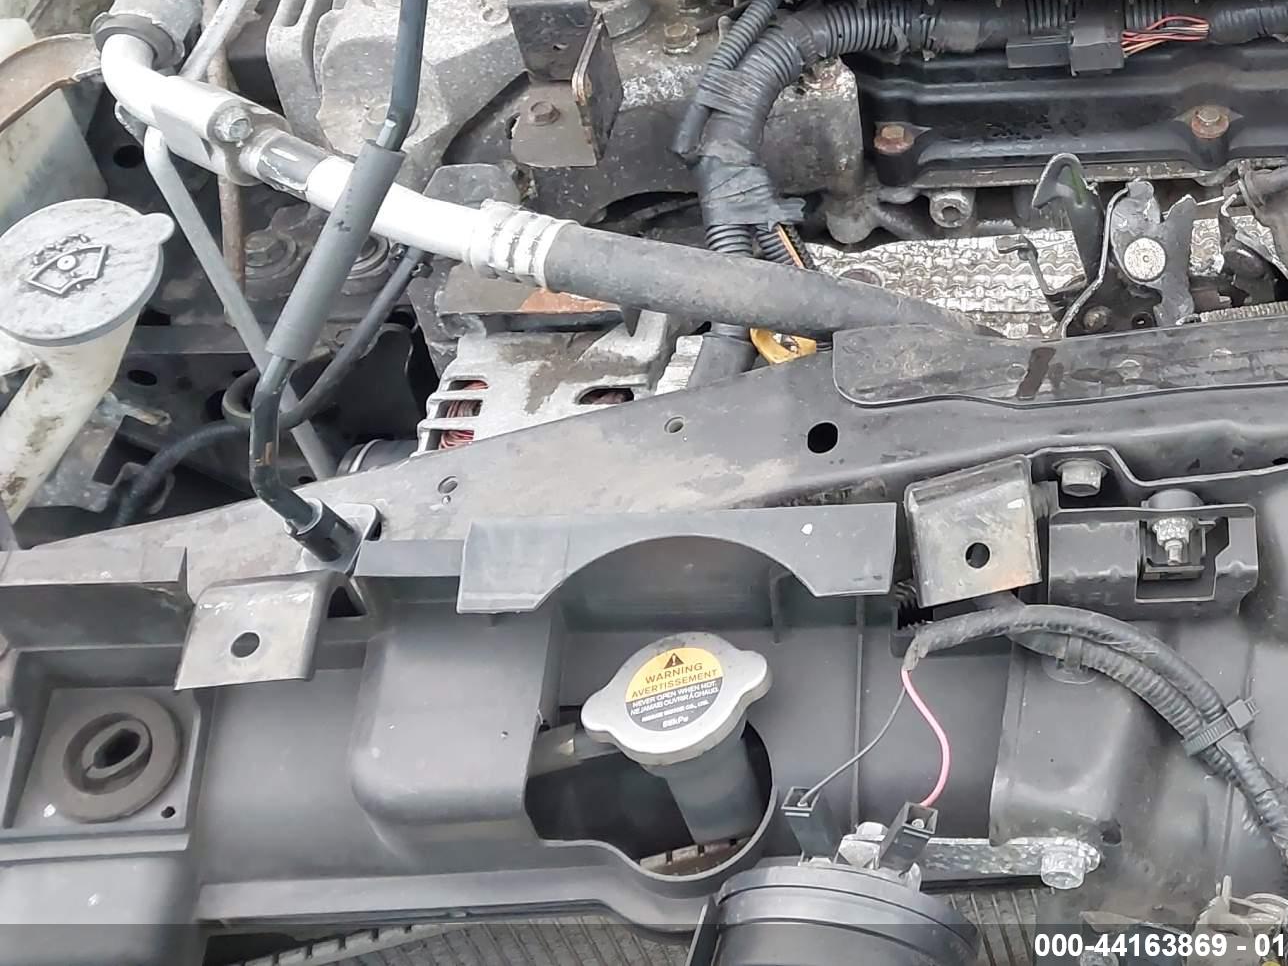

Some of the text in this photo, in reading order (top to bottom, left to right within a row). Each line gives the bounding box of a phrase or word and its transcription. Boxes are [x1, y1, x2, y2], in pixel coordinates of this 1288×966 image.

[631, 668, 718, 699] AVERTISSEMENT
[645, 662, 703, 684] WARNING
[632, 695, 655, 708] NEVER
[657, 690, 676, 702] OPEN
[678, 684, 700, 696] WHEN
